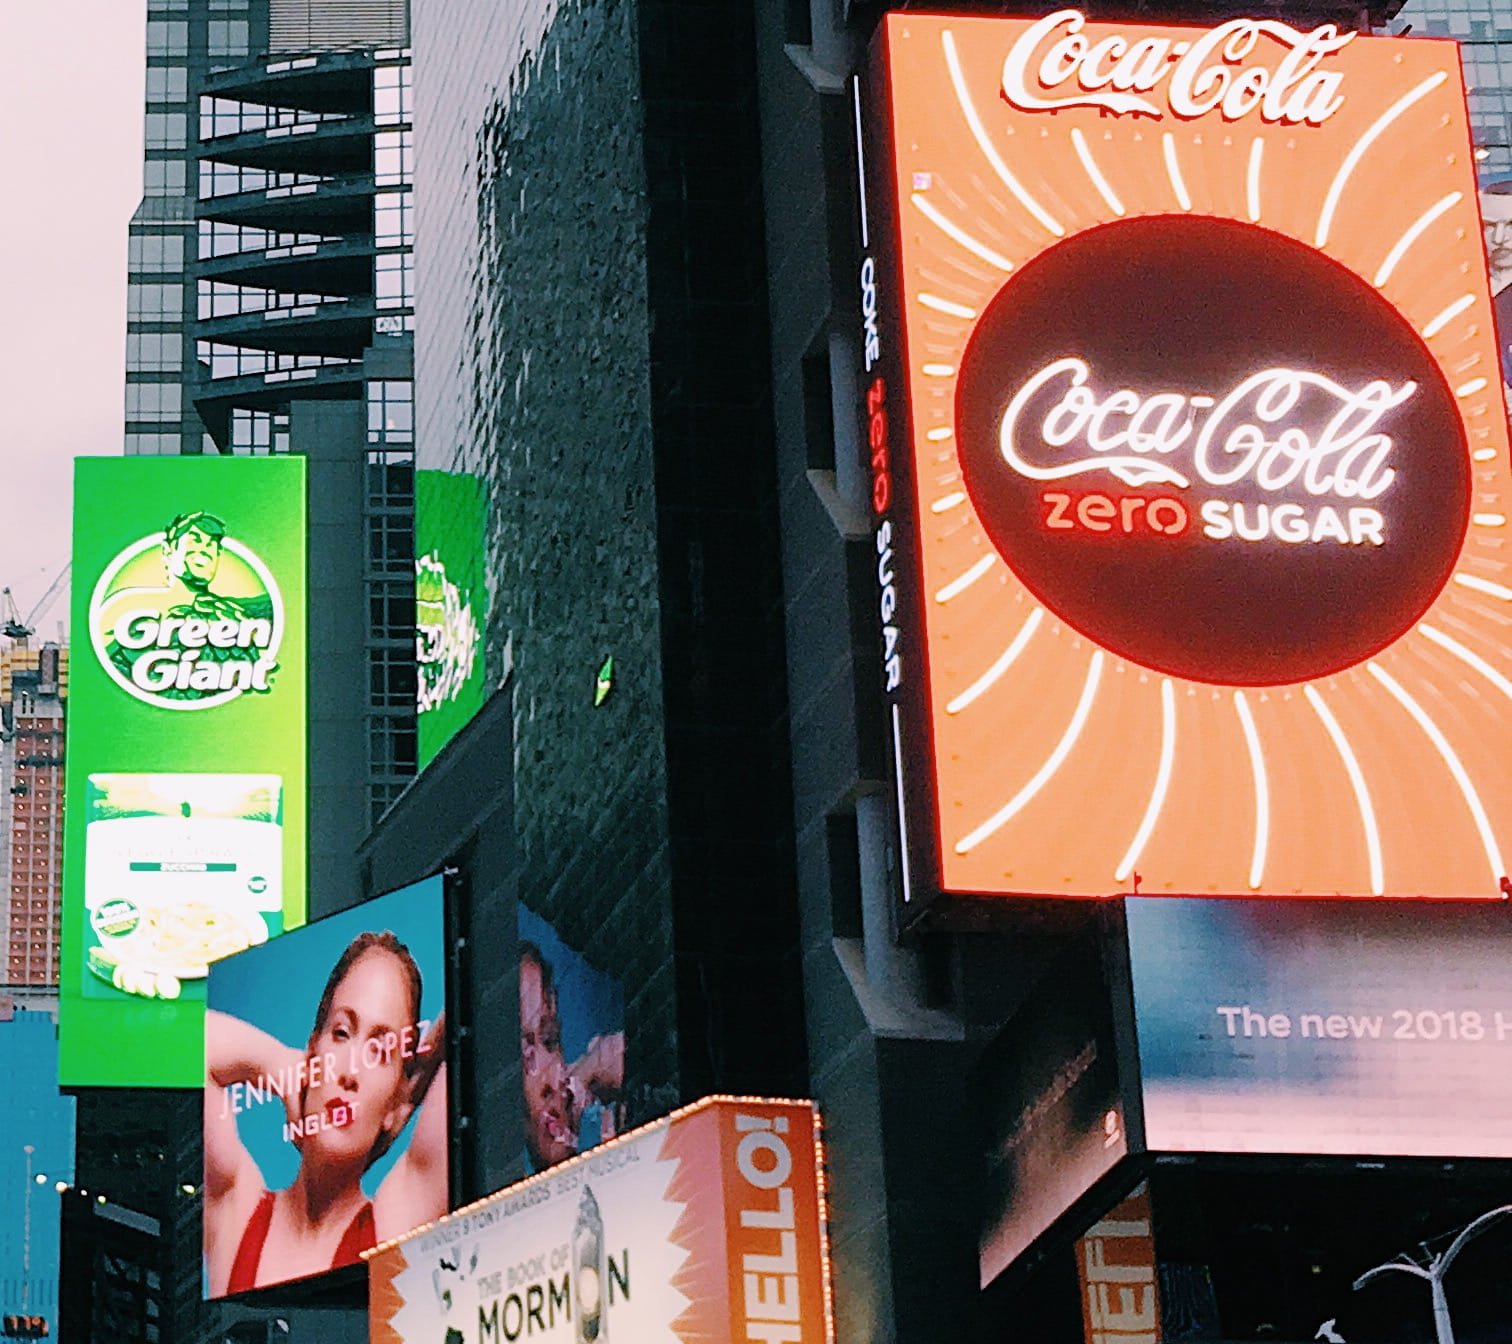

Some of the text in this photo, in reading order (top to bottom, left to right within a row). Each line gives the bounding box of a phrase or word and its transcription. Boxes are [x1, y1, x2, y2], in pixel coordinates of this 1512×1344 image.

[1001, 9, 1358, 127] Coca-Cola
[999, 357, 1418, 499] Coca-Cola
[861, 257, 900, 693] COKE zero SUGAR
[1042, 493, 1384, 546] zero SUGAR
[113, 608, 272, 649] Green
[131, 648, 277, 692] Giant
[1216, 1006, 1292, 1038] The
[1300, 1015, 1384, 1040] new
[1392, 1009, 1486, 1041] 2018
[219, 1019, 433, 1121] JENNIFER LOPEZ
[282, 1102, 360, 1143] INGLOT
[506, 1256, 546, 1288] BOOK
